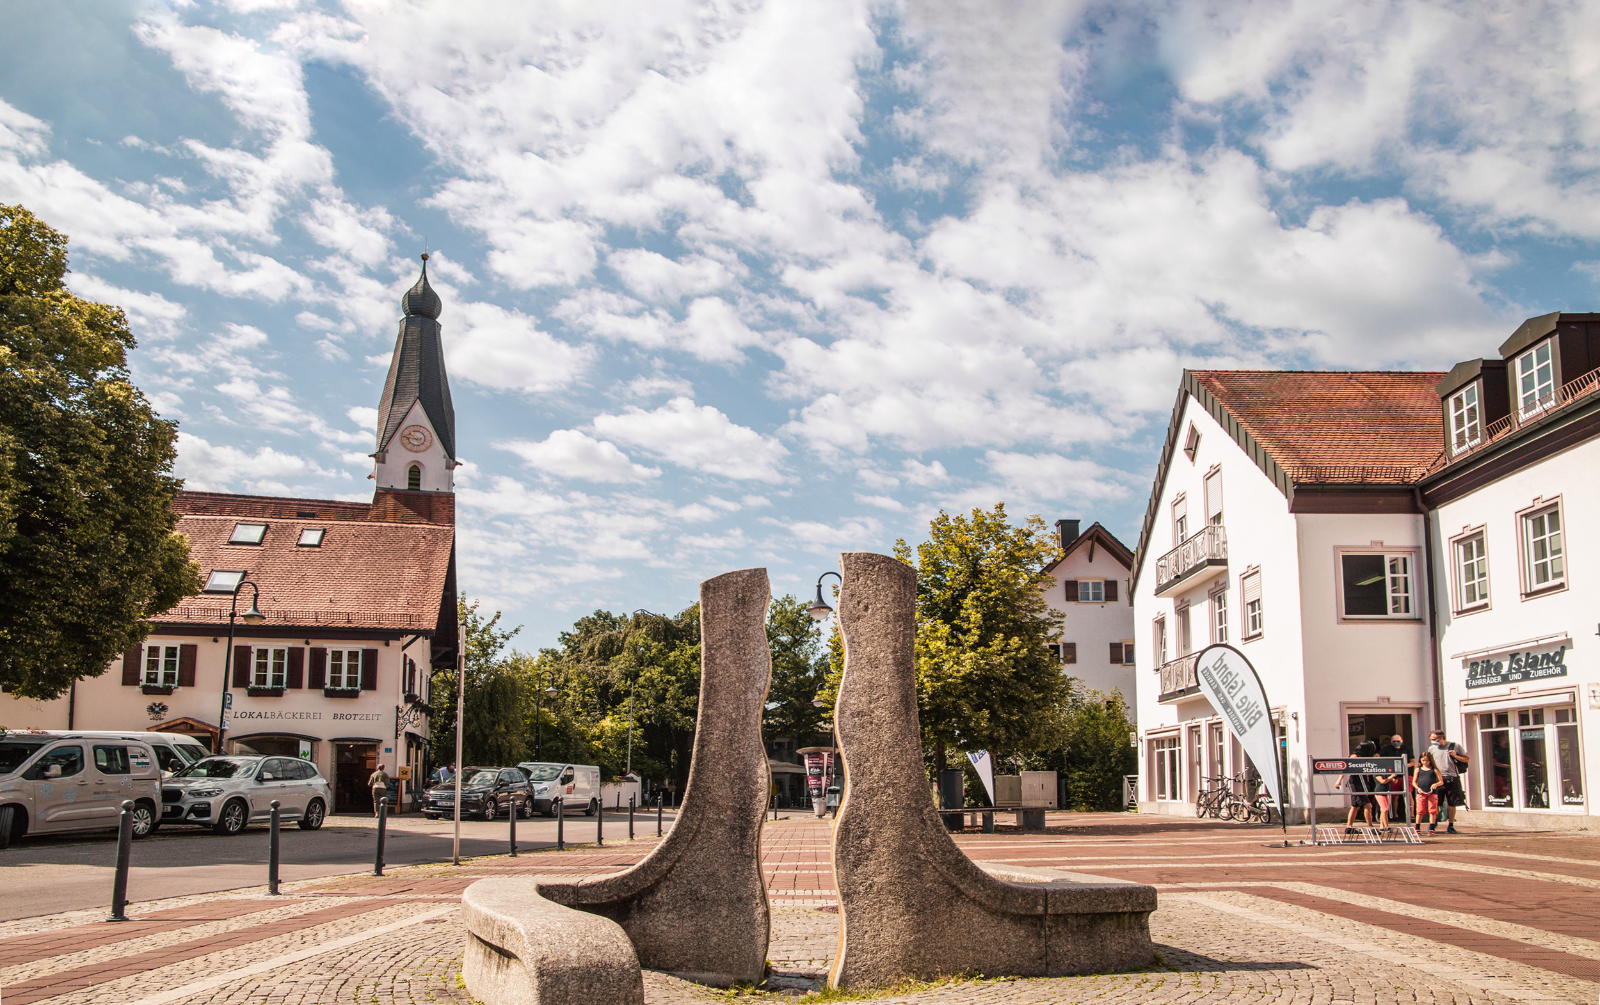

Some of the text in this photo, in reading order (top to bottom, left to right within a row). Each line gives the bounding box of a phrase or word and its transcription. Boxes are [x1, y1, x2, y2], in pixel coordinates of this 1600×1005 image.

[1467, 645, 1566, 679] Bike Island
[1468, 666, 1561, 687] FAHRRÄDER UND ZUBEHÖR
[233, 711, 322, 720] LOKALBÄCKEREI
[332, 712, 382, 721] BROTZEIT
[1348, 762, 1377, 770] Security-
